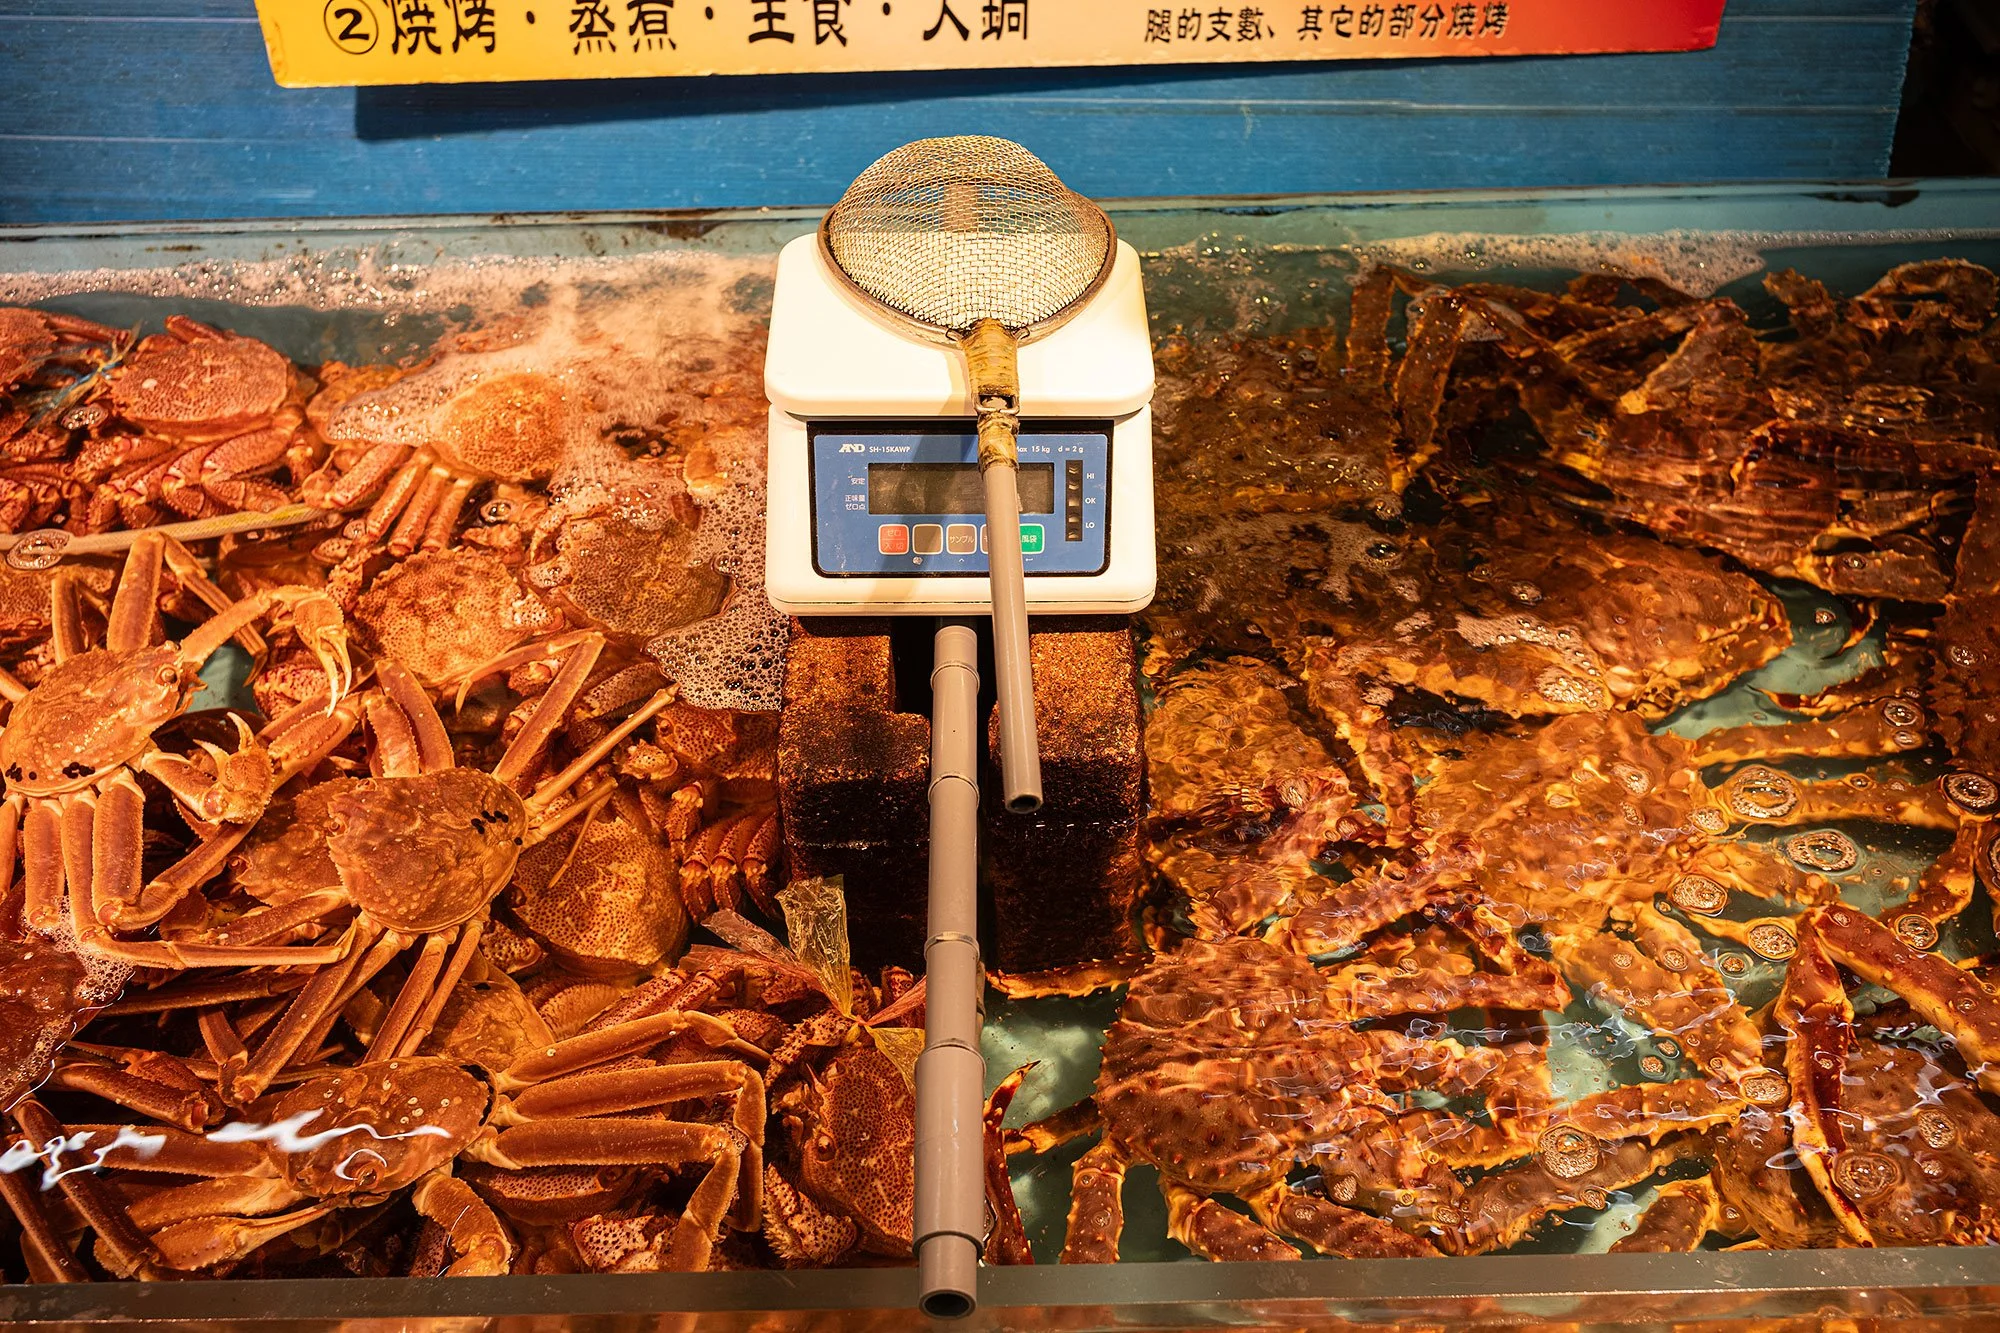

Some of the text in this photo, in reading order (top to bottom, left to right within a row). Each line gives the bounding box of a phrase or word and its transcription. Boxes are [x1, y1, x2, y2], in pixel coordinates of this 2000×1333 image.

[1031, 445, 1040, 453] 15
[1041, 445, 1050, 454] kg
[1057, 445, 1063, 453] d
[1072, 445, 1077, 453] 2
[949, 535, 975, 544] サンプル
